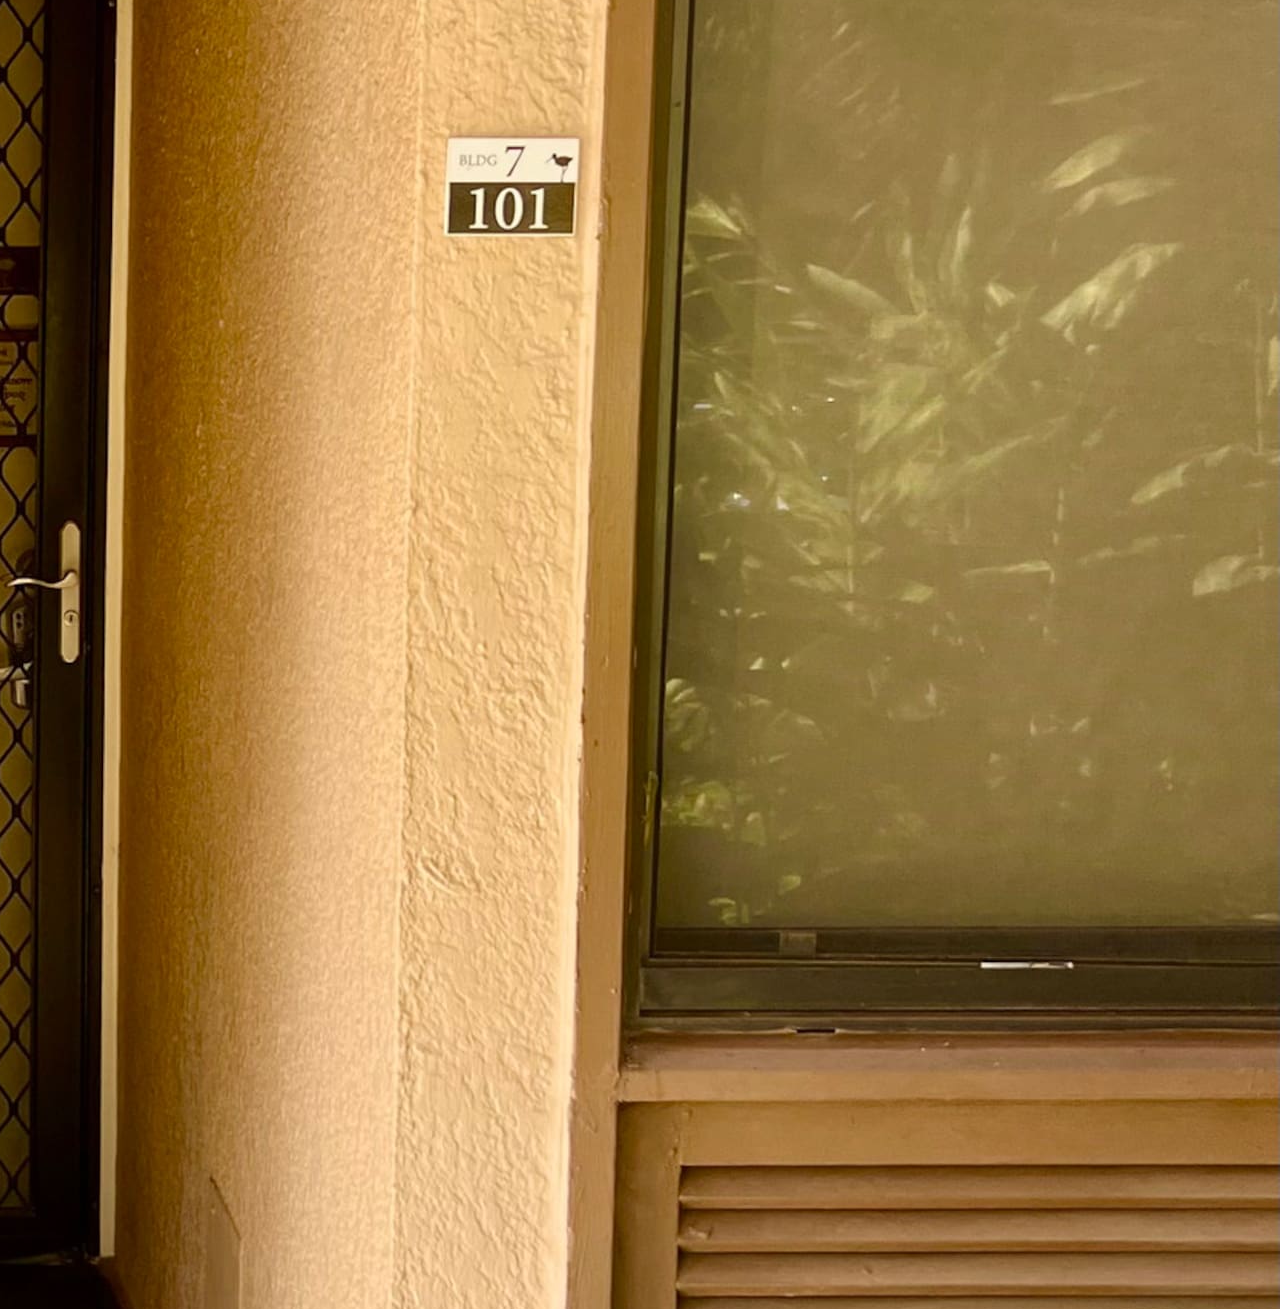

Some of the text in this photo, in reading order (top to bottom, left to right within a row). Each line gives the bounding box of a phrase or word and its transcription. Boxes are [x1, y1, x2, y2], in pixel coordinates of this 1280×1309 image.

[459, 146, 526, 177] BLDG 7
[468, 187, 549, 230] 101
